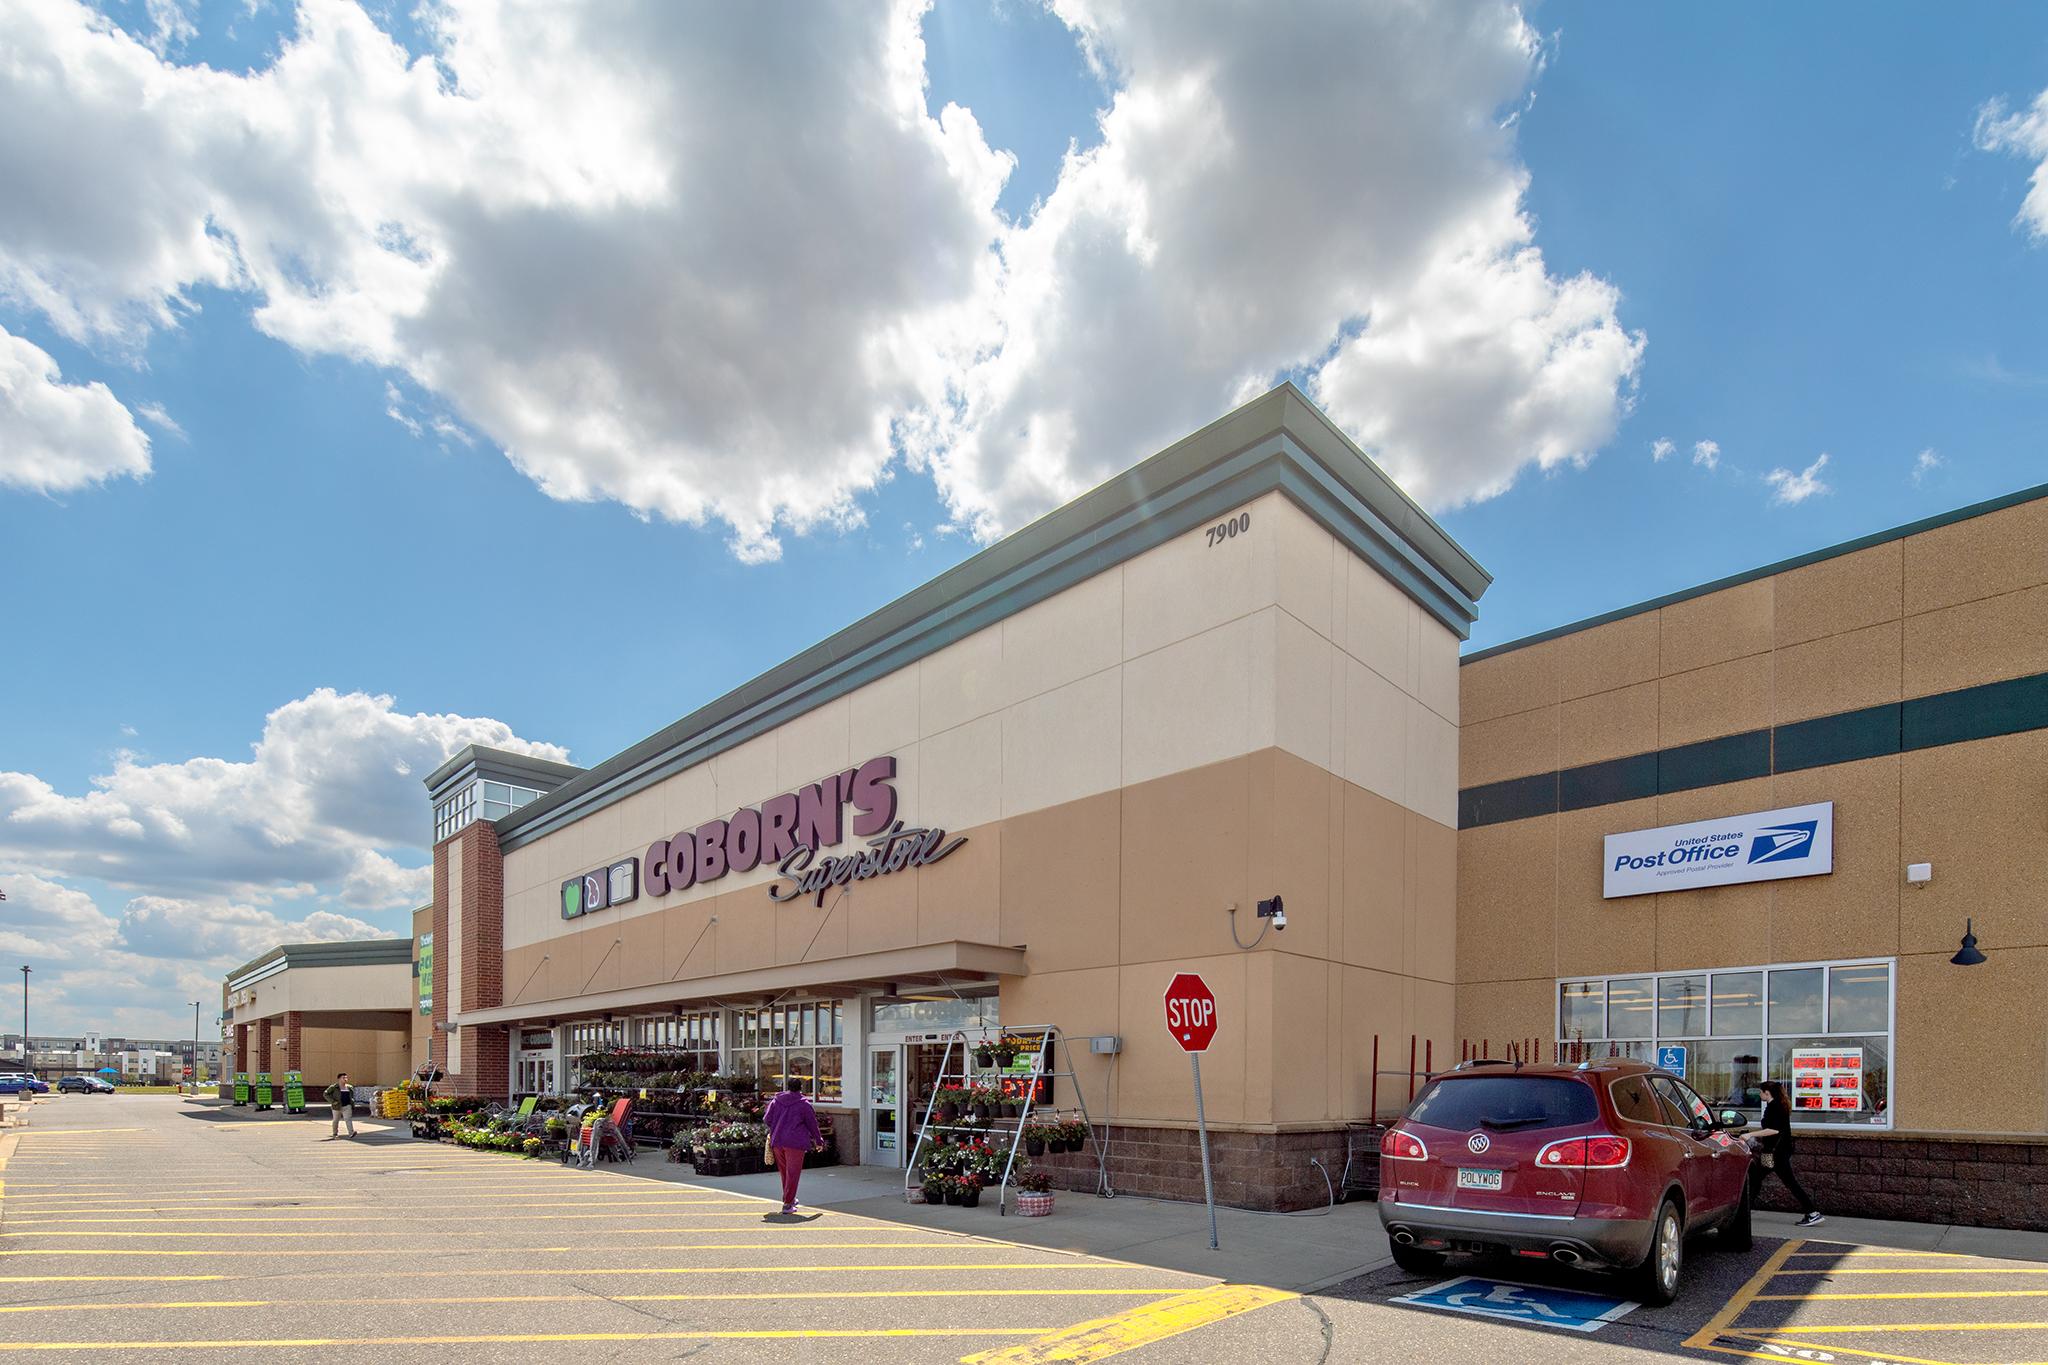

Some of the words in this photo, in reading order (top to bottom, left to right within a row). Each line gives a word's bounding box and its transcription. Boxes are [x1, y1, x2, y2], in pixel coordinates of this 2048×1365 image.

[1206, 512, 1250, 548] 7900
[644, 756, 897, 897] COBORN'S
[1674, 836, 1708, 847] United
[1709, 831, 1743, 842] States
[768, 820, 968, 907] Superstore
[1614, 851, 1667, 872] Post
[1668, 843, 1740, 865] Office
[1656, 867, 1685, 876] Approved
[1686, 864, 1706, 873] Postal
[1707, 861, 1734, 871] Provider
[1169, 998, 1213, 1027] STOP
[905, 1034, 923, 1043] ENTER
[1461, 1172, 1500, 1185] POLYWOG
